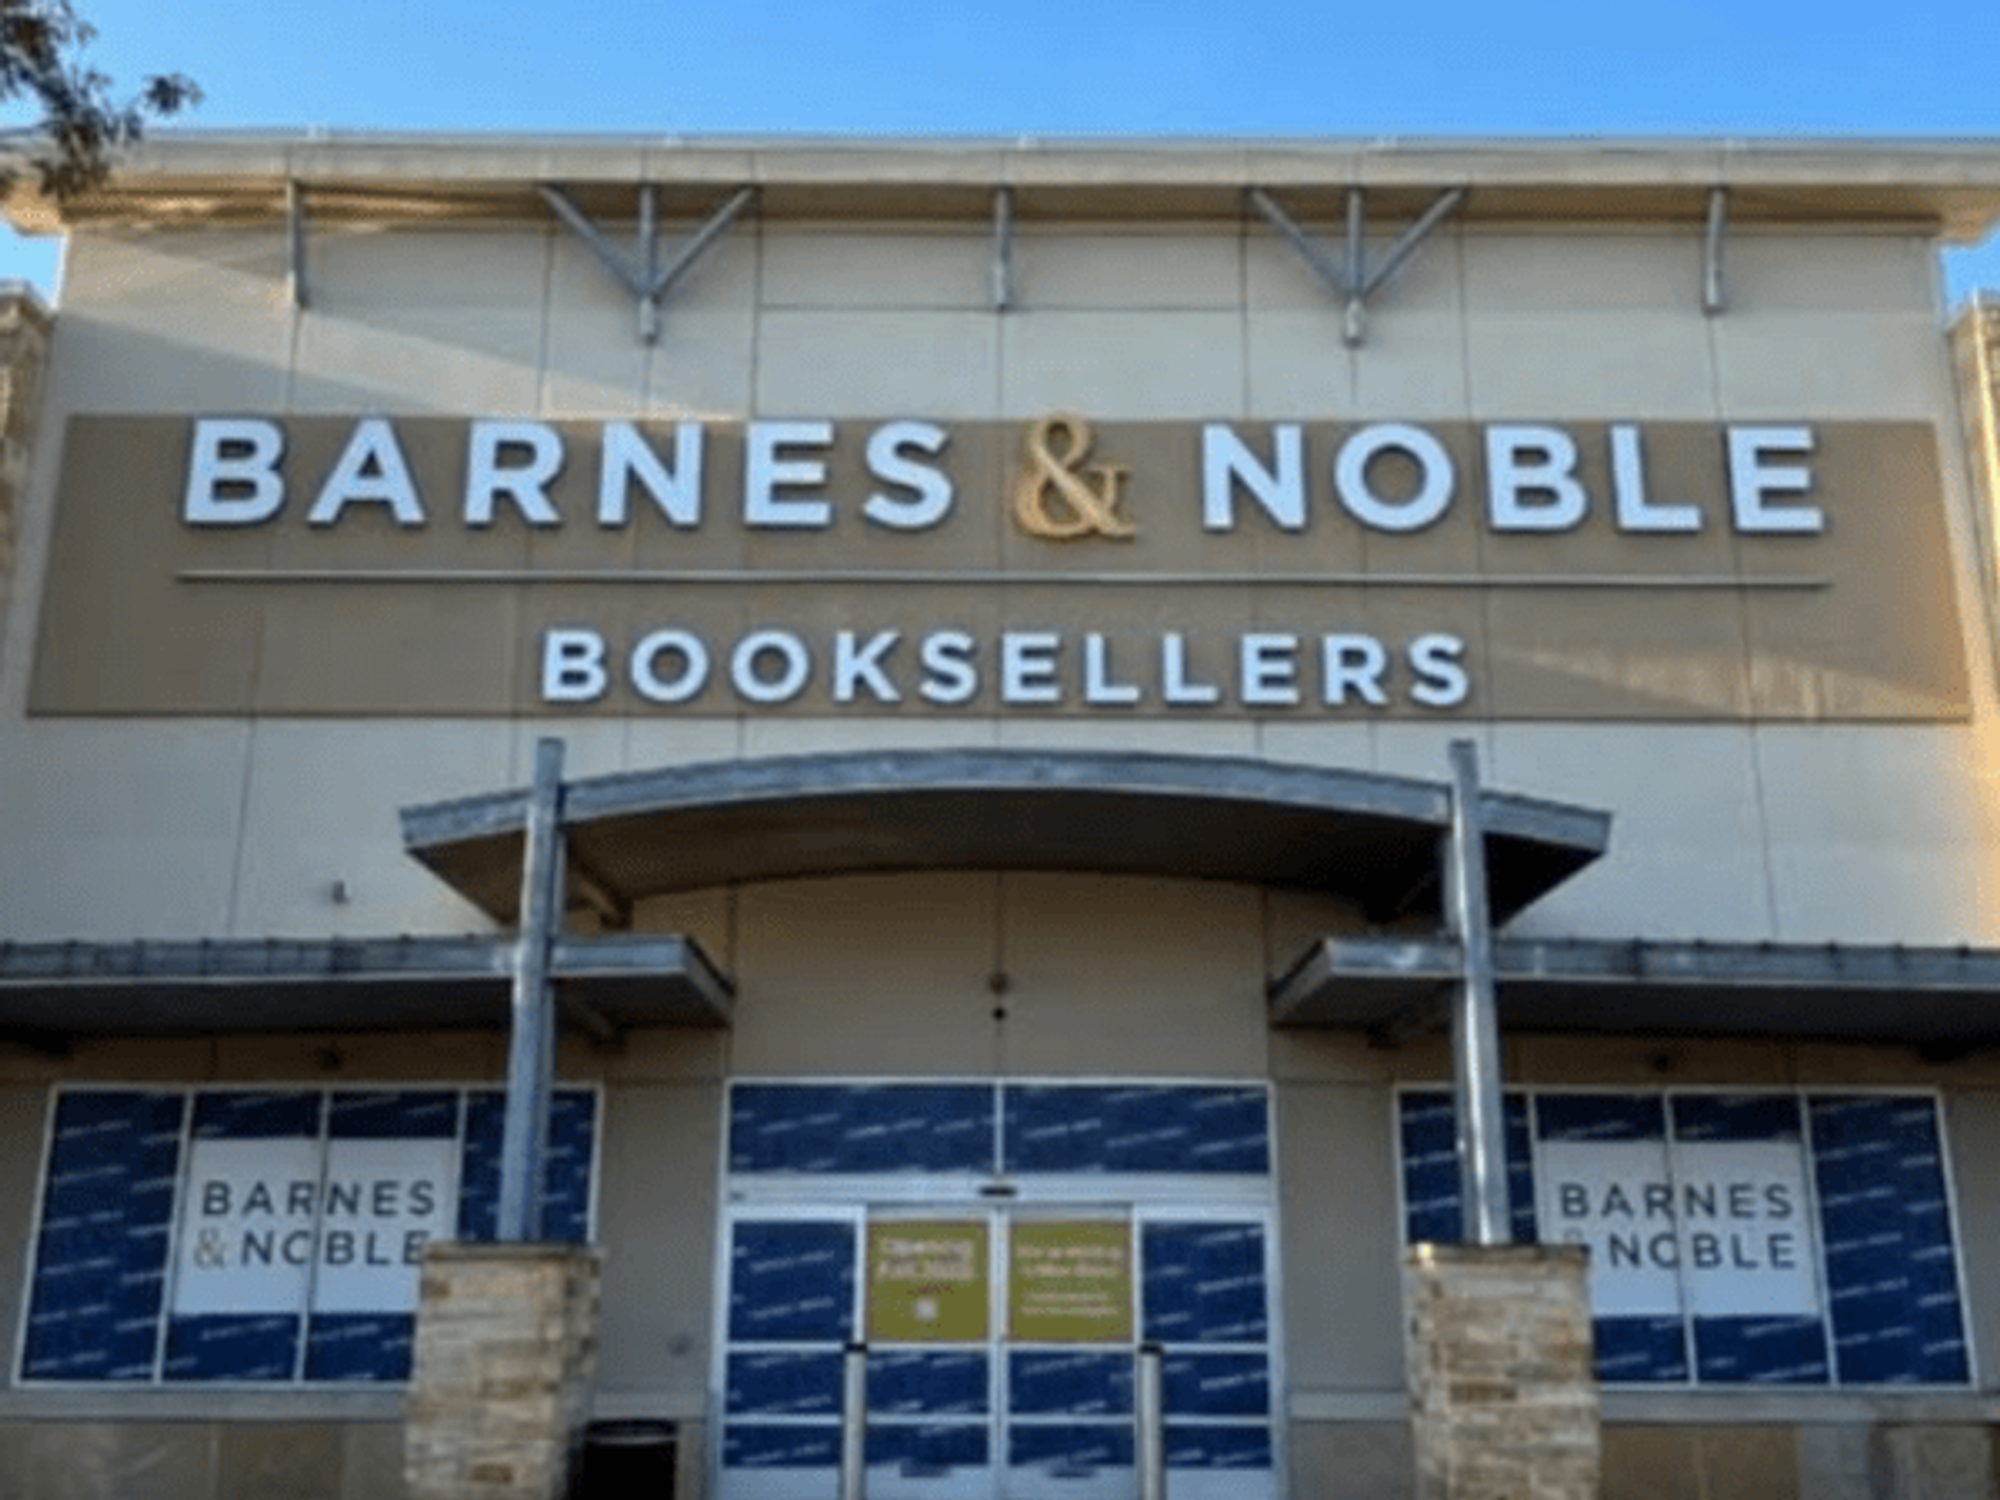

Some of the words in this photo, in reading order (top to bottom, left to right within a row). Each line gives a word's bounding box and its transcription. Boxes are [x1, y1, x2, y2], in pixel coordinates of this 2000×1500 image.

[184, 418, 956, 530] BARNES
[1013, 413, 1136, 541] &
[1201, 422, 1826, 535] NOBLE
[541, 628, 1473, 707] BOOKSELLERS
[202, 1180, 435, 1216] BARNES
[1559, 1183, 1793, 1219] BARNES
[194, 1226, 226, 1268] &
[240, 1229, 432, 1266] NOBLE
[1609, 1232, 1797, 1269] NOBLE
